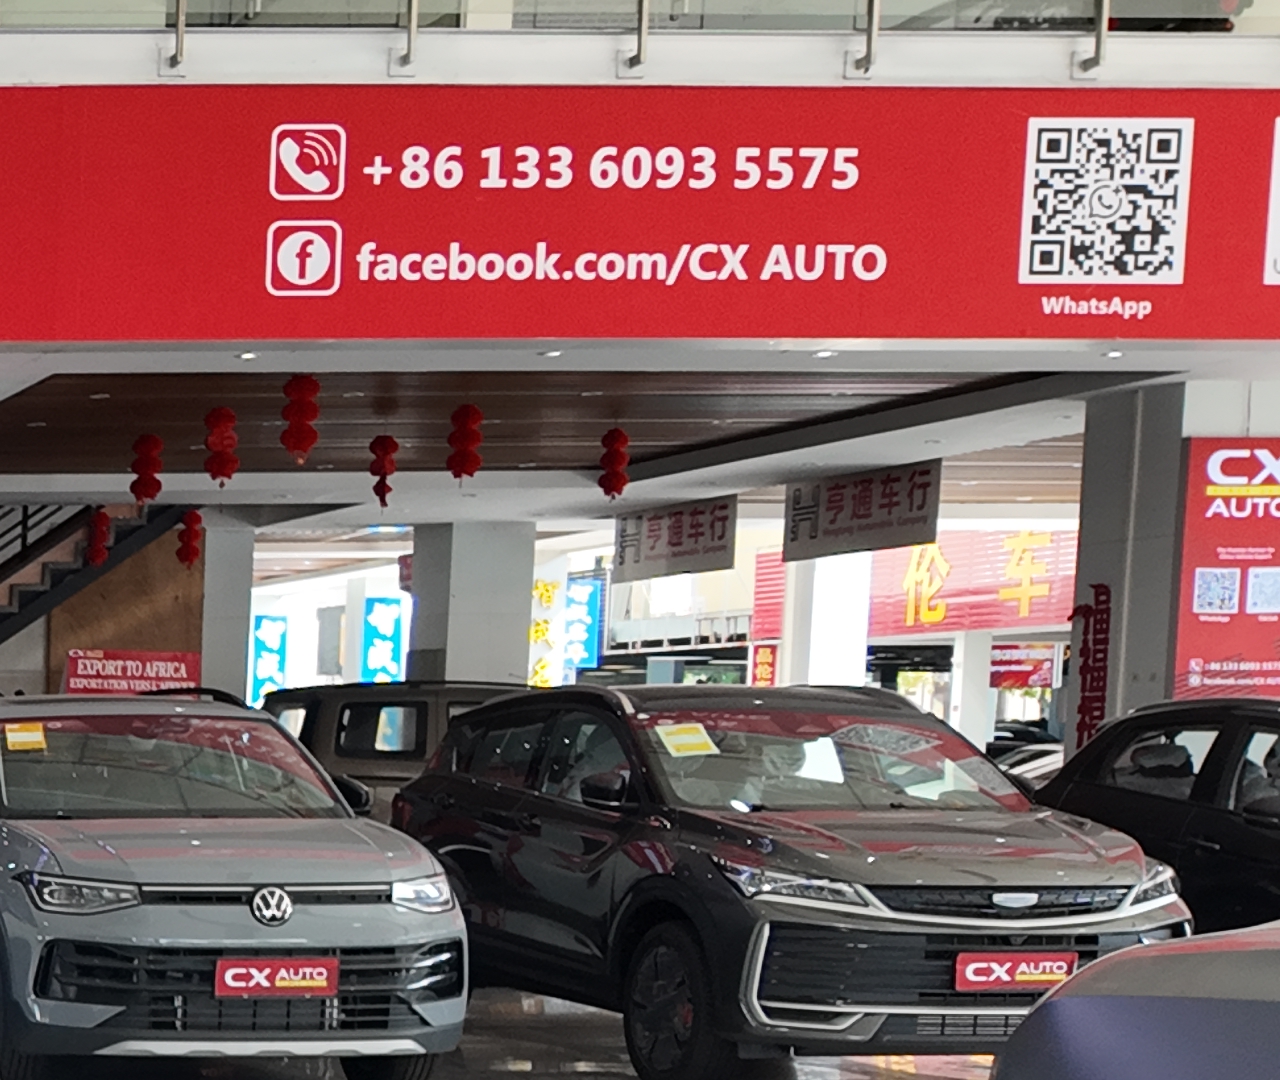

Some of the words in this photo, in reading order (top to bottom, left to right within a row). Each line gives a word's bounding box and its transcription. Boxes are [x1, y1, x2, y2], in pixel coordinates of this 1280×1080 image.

[363, 146, 463, 189] +86
[479, 146, 573, 189] 133
[589, 146, 716, 189] 6093
[733, 147, 860, 190] 5575
[356, 242, 749, 286] facebook.com/CX
[760, 244, 887, 282] AUTO
[1042, 296, 1152, 319] WhatsApp
[77, 659, 123, 676] EXPORT
[125, 660, 142, 677] TO
[143, 662, 187, 679] AFRICA
[224, 967, 271, 987] CX
[275, 967, 328, 980] AUTO
[965, 962, 1013, 981] CX
[1014, 961, 1068, 974] AUTO
